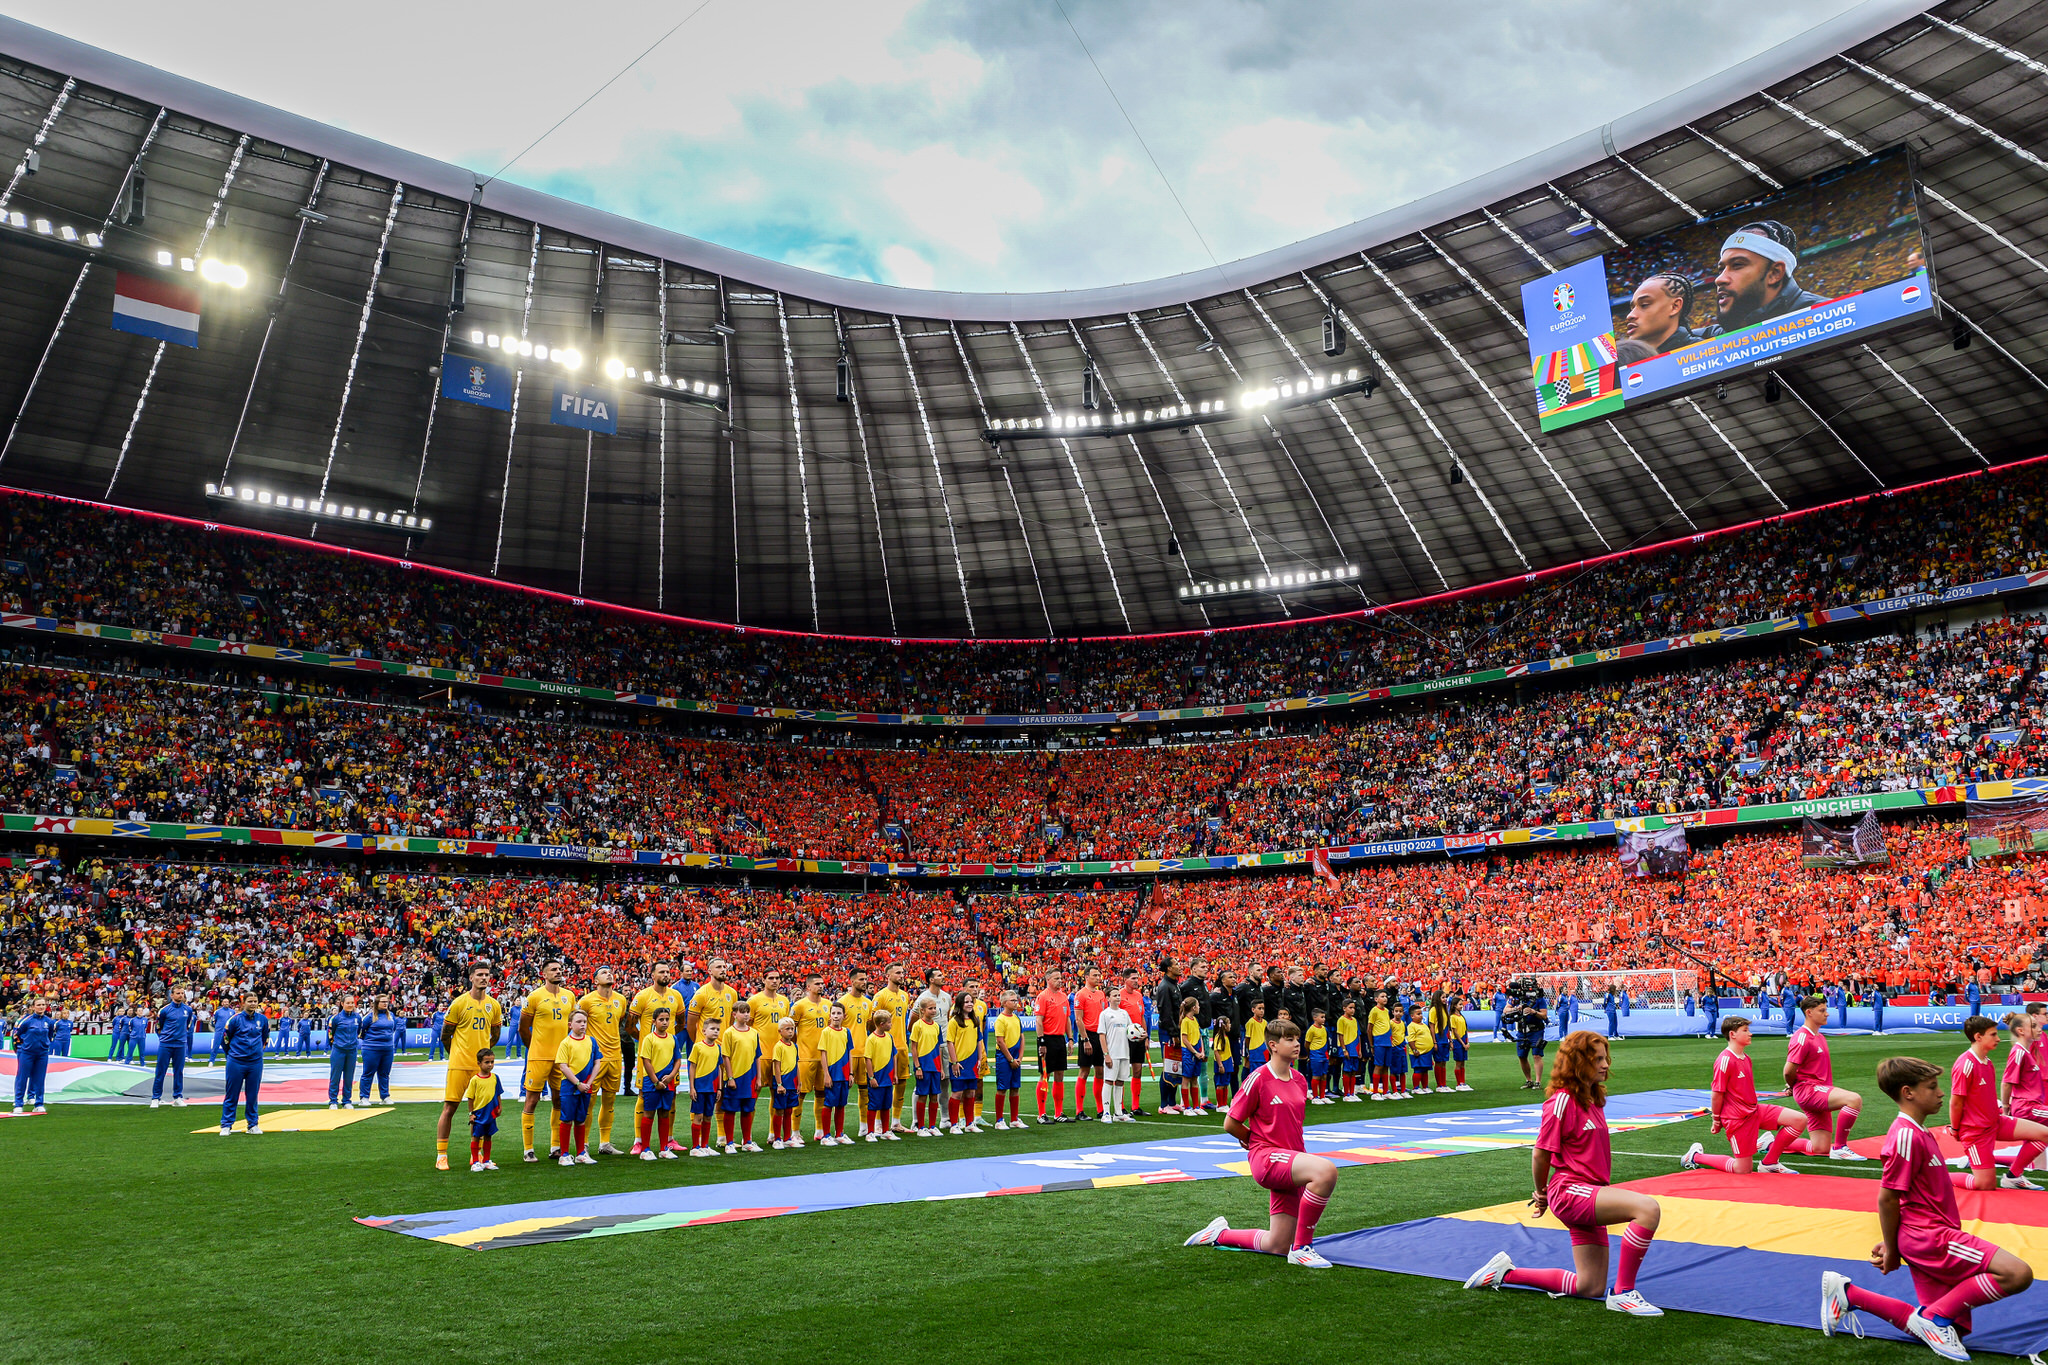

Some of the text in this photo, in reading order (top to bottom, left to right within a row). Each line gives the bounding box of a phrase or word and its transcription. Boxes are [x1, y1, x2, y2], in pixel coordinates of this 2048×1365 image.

[1676, 302, 1856, 365] WILHELMUS VAN NASSOUWE
[1682, 317, 1857, 377] BEN IK, VAN DUITSEN BLOED,
[1753, 355, 1783, 367] Hisense
[561, 393, 609, 421] FIFA
[540, 683, 581, 695] MUNICH
[1423, 676, 1472, 690] MÜNCHEN
[1792, 798, 1873, 815] MÜNCHEN
[552, 1008, 562, 1020] 15
[719, 1006, 725, 1018] 3
[896, 1006, 903, 1017] 19
[473, 1017, 486, 1030] 20
[606, 1012, 613, 1024] 2
[771, 1012, 780, 1024] 10
[815, 1017, 825, 1028] 18
[856, 1013, 863, 1024] 6
[1914, 1013, 1962, 1025] PEACE
